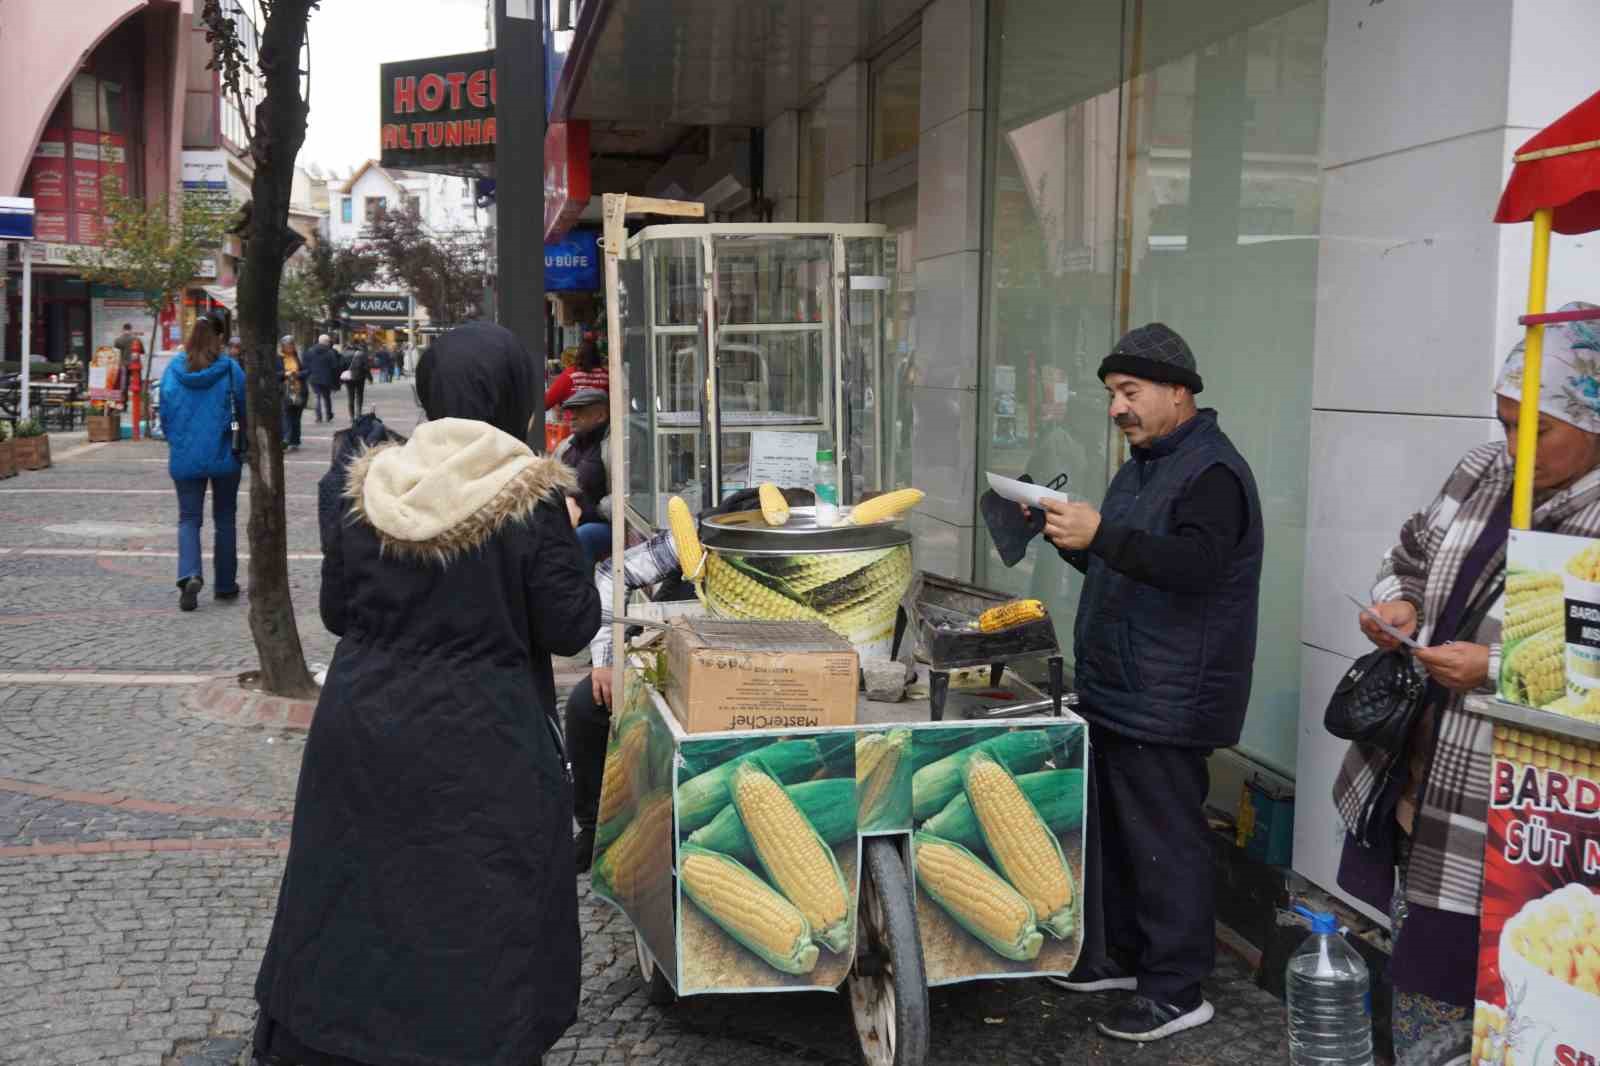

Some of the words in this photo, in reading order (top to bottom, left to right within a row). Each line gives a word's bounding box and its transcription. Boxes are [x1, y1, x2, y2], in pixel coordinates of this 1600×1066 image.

[360, 300, 404, 311] KARACA
[727, 714, 819, 730] MasterChef
[1504, 814, 1571, 867] SÜT
